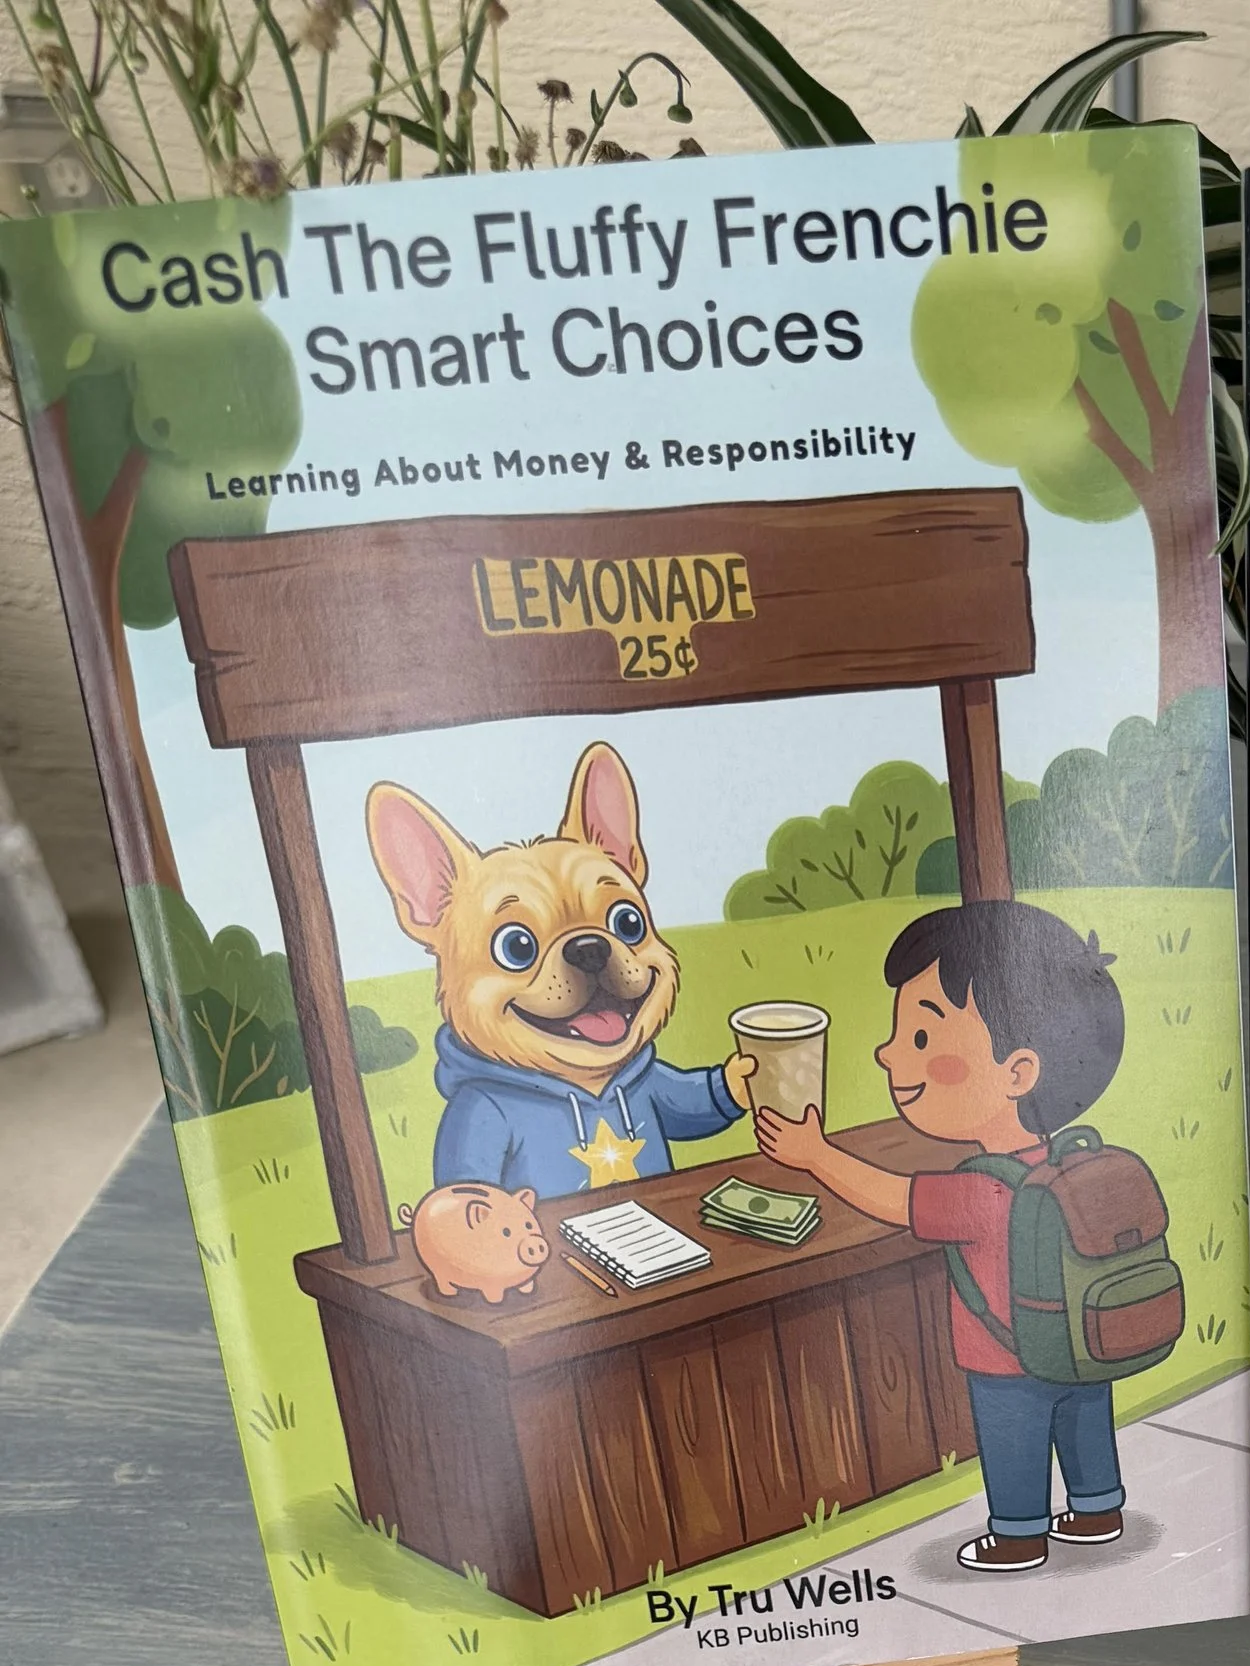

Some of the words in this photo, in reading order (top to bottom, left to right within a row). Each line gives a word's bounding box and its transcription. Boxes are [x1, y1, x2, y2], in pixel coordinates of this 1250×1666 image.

[101, 230, 289, 312] Cash
[305, 222, 451, 298] The
[475, 201, 688, 288] Fluffy
[713, 183, 1048, 270] Frenchie
[307, 311, 530, 397] Smart
[551, 300, 863, 379] Choices
[206, 462, 361, 501] Learning
[374, 450, 481, 489] About
[492, 443, 610, 483] Money
[624, 440, 649, 470] &
[662, 425, 916, 469] Responsibility
[477, 556, 753, 632] LEMONADE
[620, 634, 695, 678] 25¢
[646, 1590, 698, 1629] By
[708, 1584, 773, 1617] Tru
[783, 1568, 896, 1610] Wells
[697, 1628, 729, 1649] KB
[737, 1615, 859, 1645] Publishing
